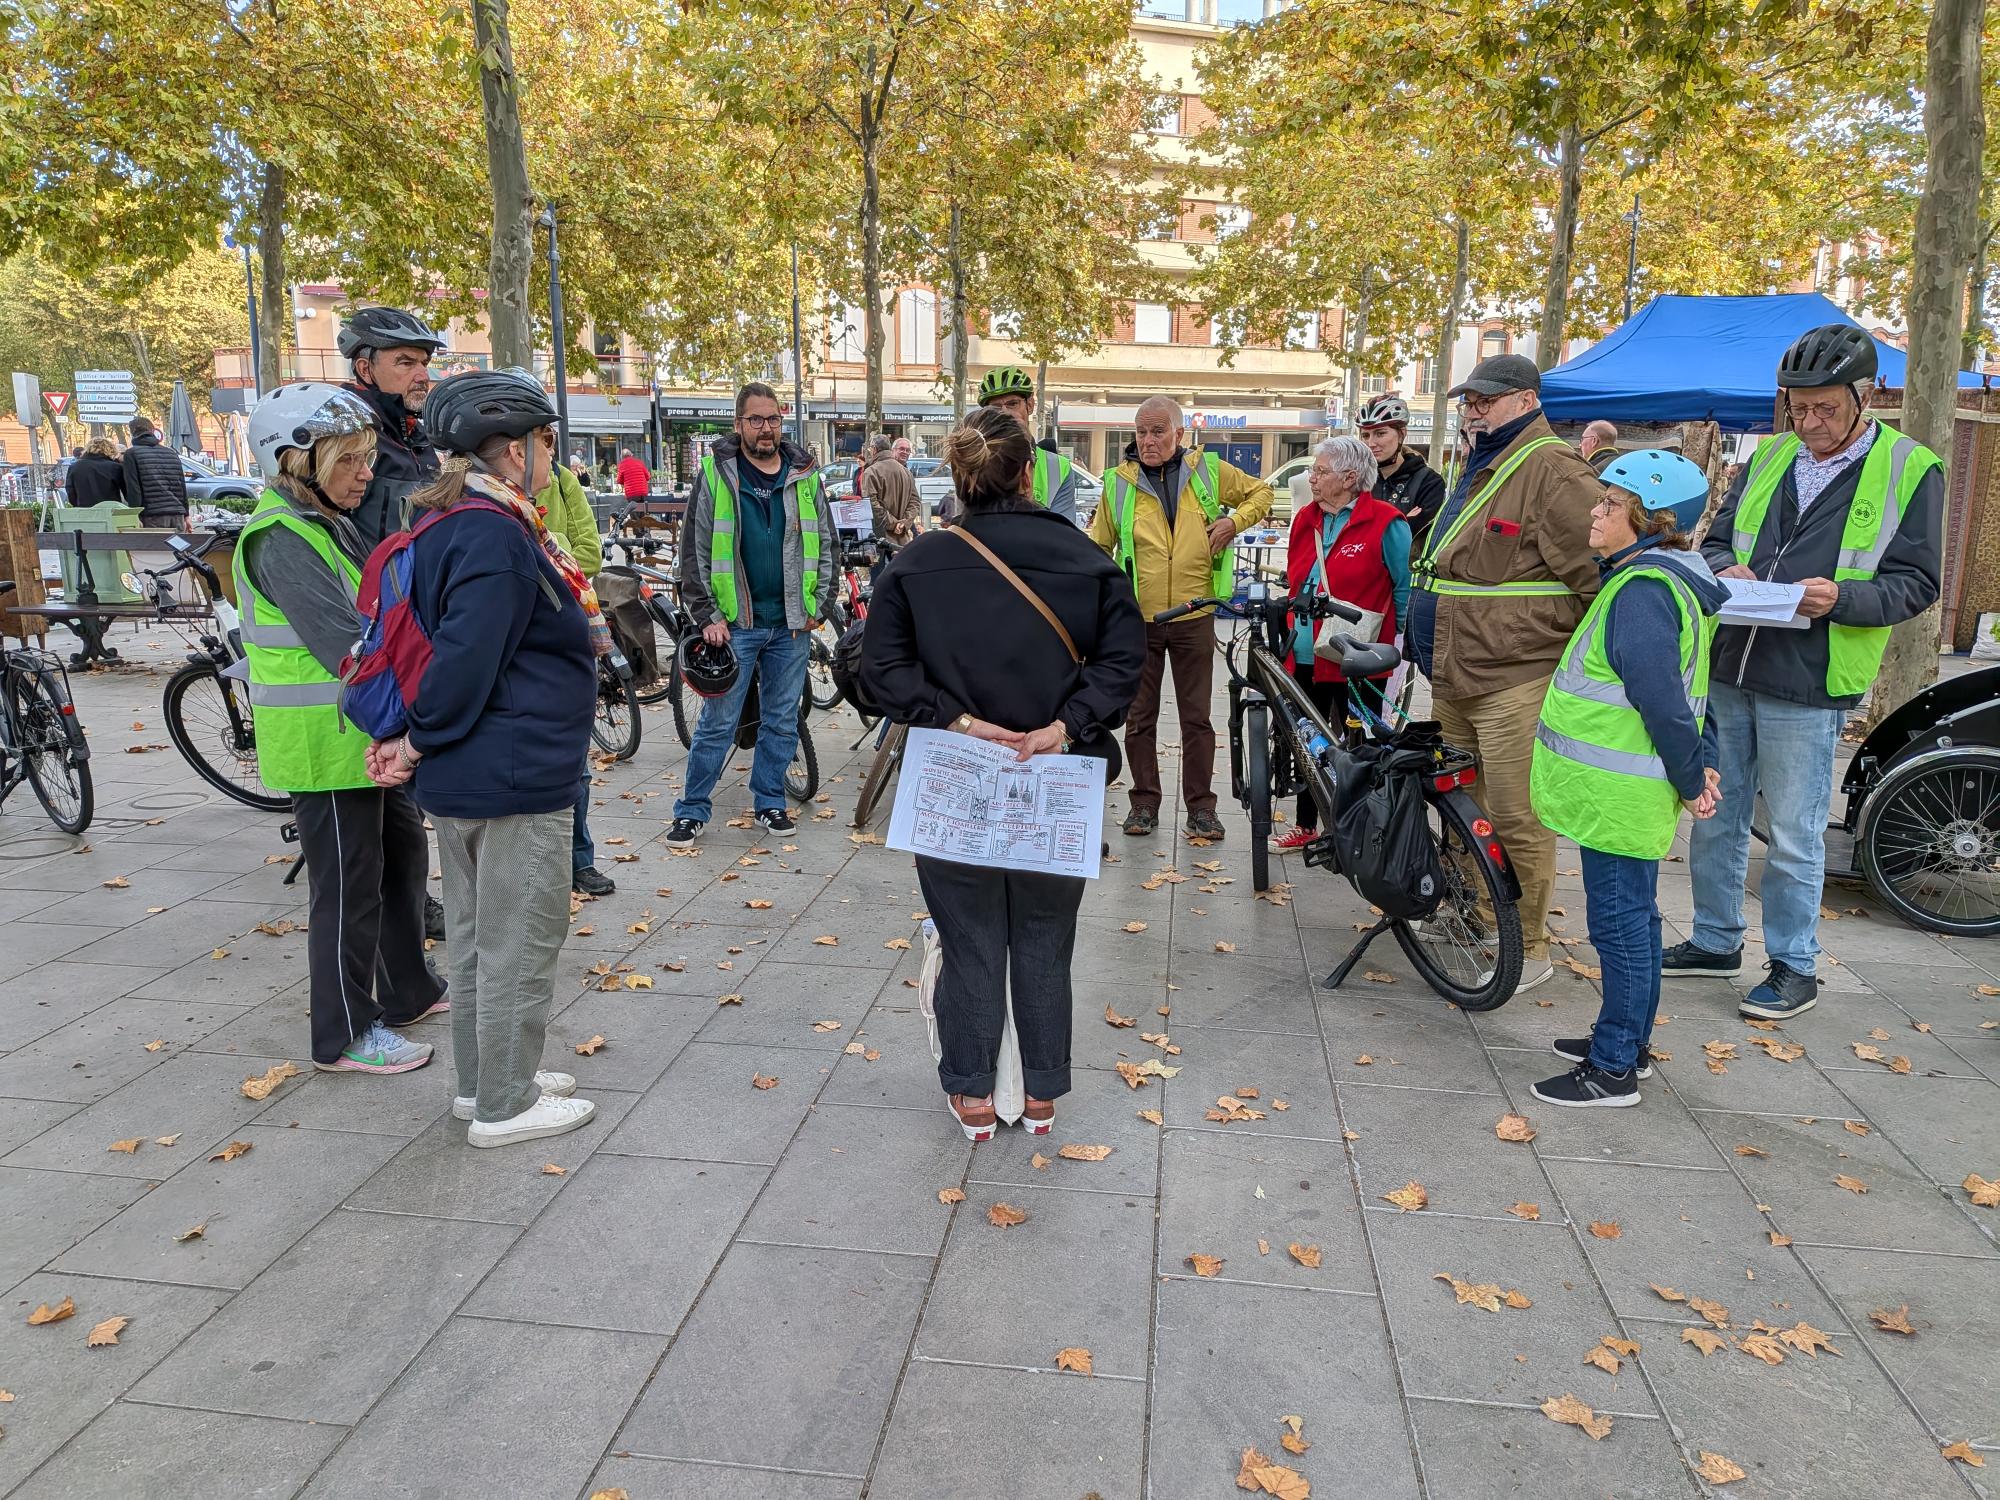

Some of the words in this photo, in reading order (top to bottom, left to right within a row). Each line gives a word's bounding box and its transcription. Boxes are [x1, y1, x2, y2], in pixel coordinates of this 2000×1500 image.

[815, 412, 839, 420] presse
[922, 414, 955, 422] papeterie
[1207, 414, 1247, 428] Mutuel
